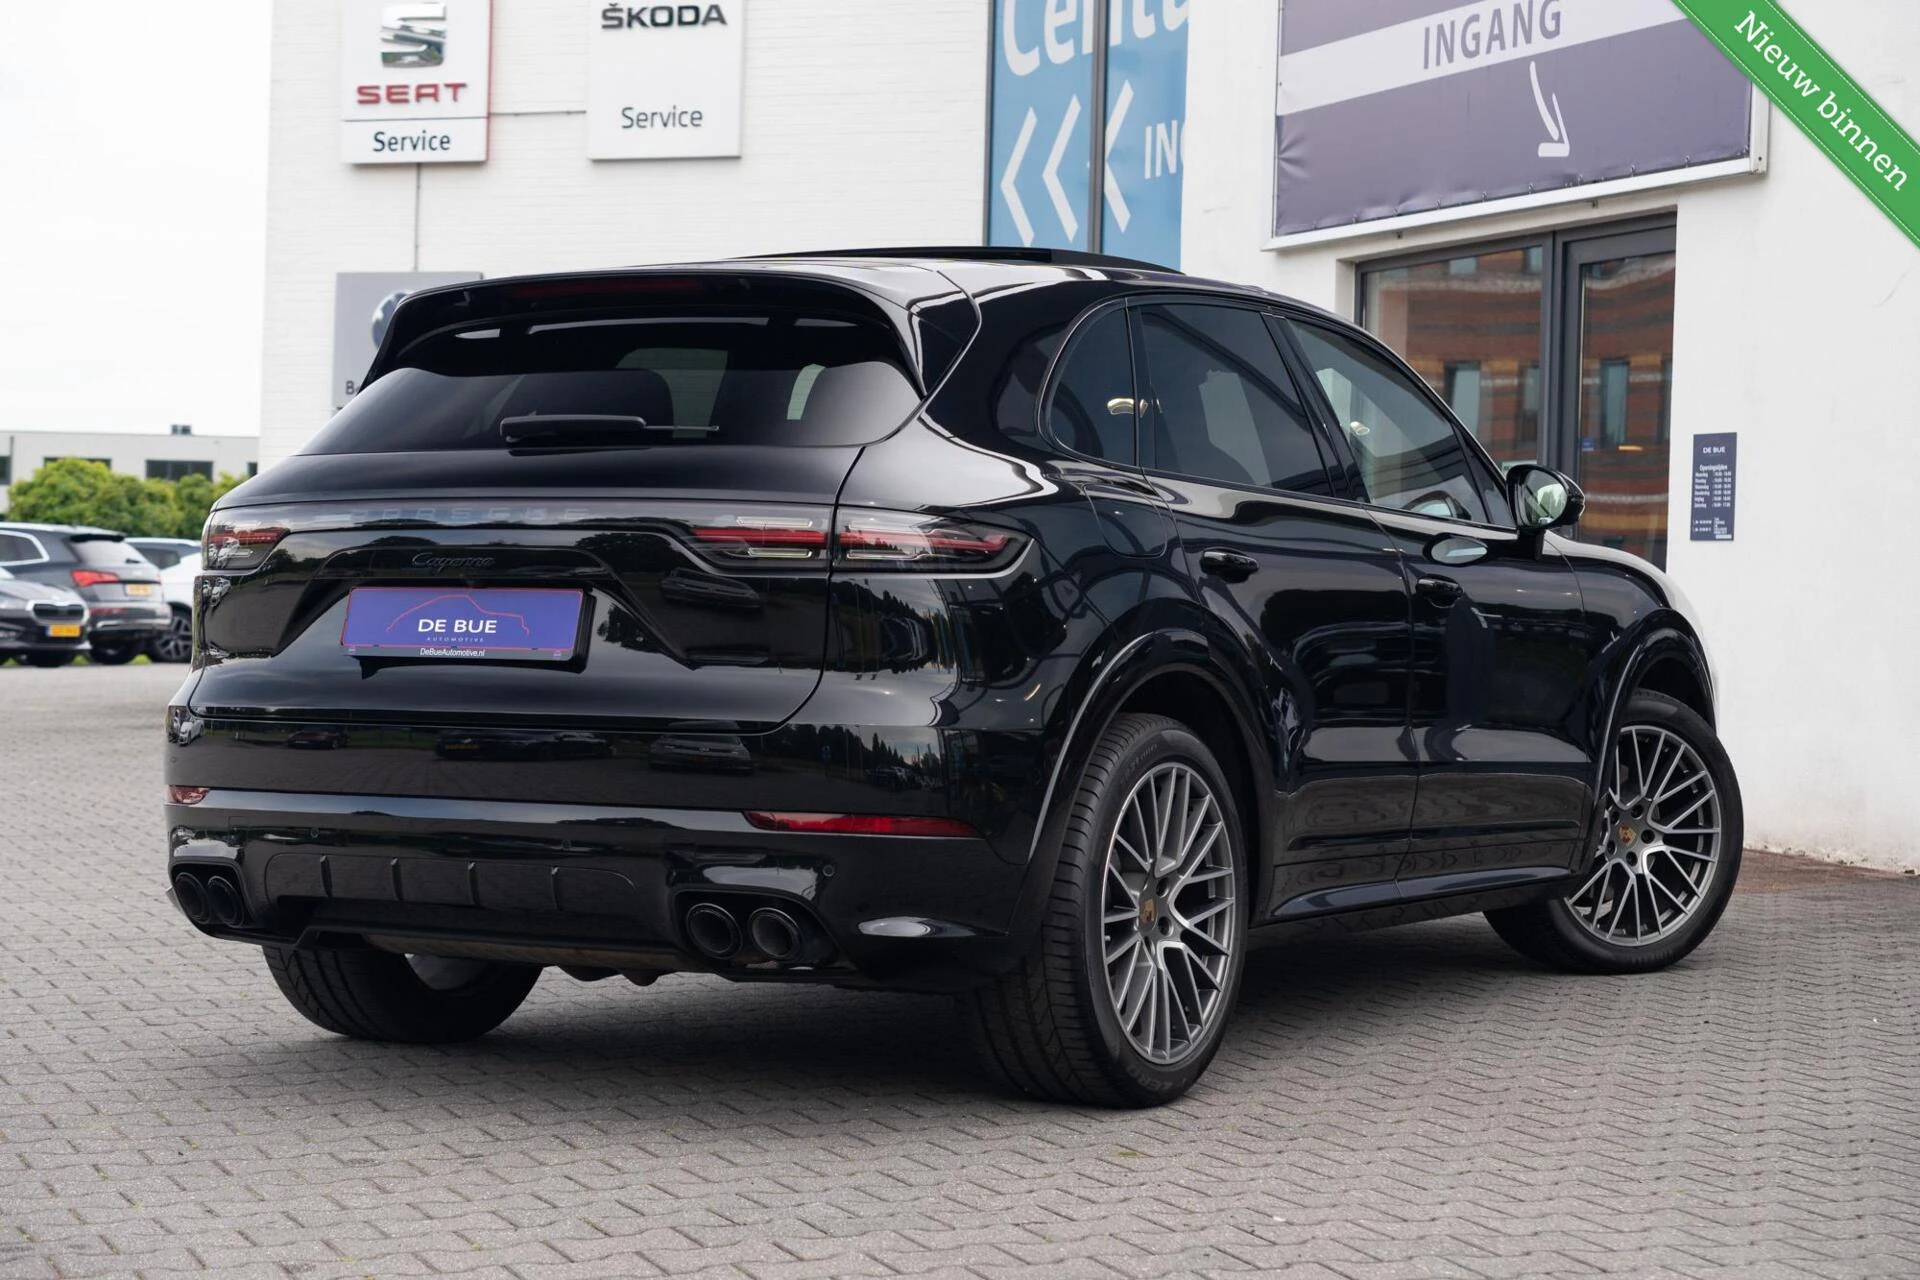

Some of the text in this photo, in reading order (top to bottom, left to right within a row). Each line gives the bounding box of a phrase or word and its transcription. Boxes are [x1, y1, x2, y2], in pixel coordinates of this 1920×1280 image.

[600, 3, 728, 30] ŠKODA
[1422, 0, 1562, 70] INGANG
[356, 82, 468, 106] SEAT
[620, 105, 704, 130] Service
[372, 130, 451, 152] Service
[1144, 119, 1185, 180] IN
[411, 551, 496, 574] Cayenne
[417, 618, 498, 634] DE BUE
[419, 647, 486, 657] DeBueAutomotive.nl
